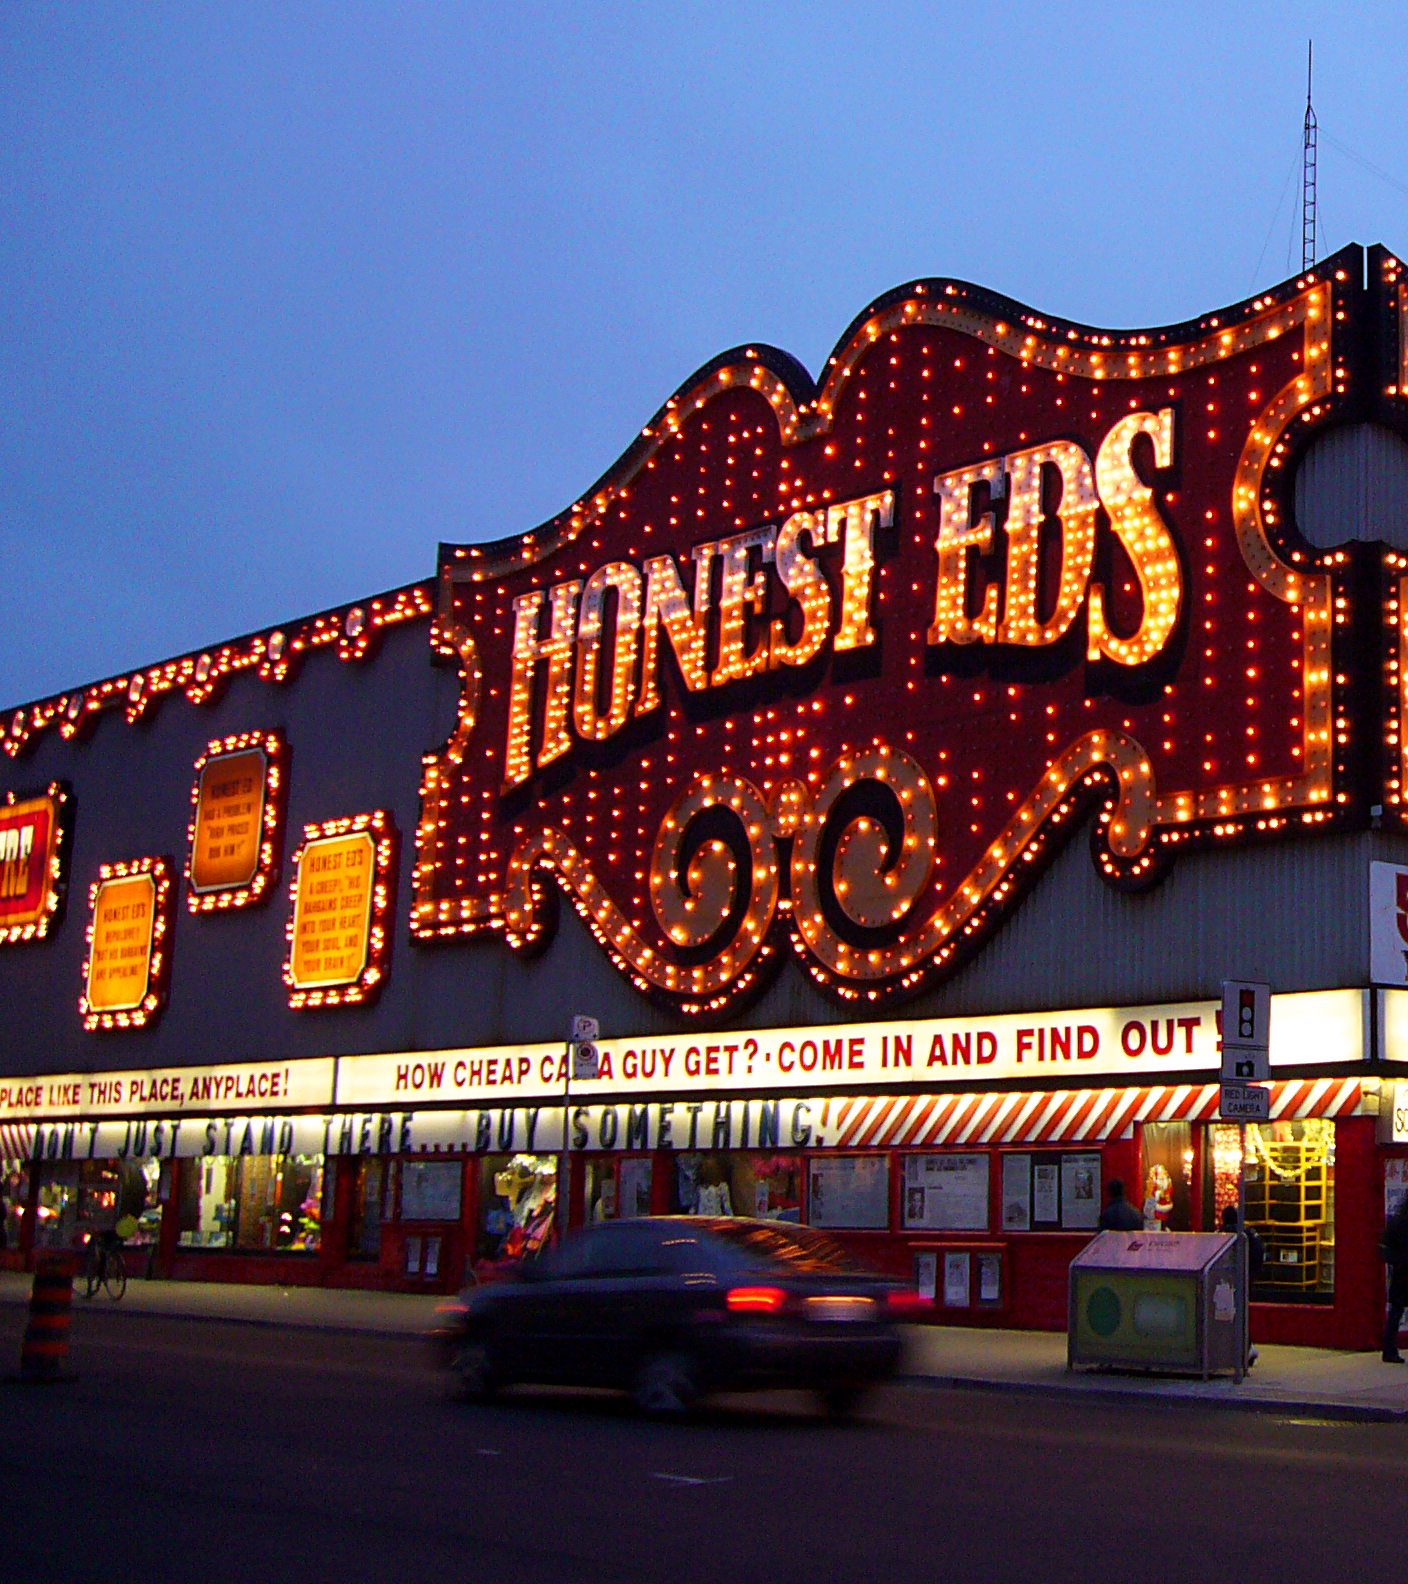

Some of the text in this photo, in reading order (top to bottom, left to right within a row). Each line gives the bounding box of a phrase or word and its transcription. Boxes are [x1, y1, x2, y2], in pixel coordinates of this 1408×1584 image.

[504, 408, 1183, 785] HONEST EDS
[396, 1062, 445, 1090] HOW
[454, 1057, 531, 1087] CHEAP
[599, 1051, 614, 1080] A
[622, 1047, 676, 1079] GUY
[684, 1038, 758, 1077] GET?
[779, 1037, 865, 1073] COME
[881, 1034, 913, 1068] IN
[927, 1031, 998, 1067] AND
[1016, 1024, 1100, 1063] FIND
[0, 1068, 290, 1108] PLACE LIKE THIS PLACE, ANYPLACE!
[1225, 1089, 1264, 1101] RED LIGHT
[1227, 1102, 1261, 1113] CAMERA
[118, 1120, 181, 1158] JUST
[204, 1117, 293, 1156] STAND
[475, 1108, 538, 1151] BUY
[572, 1100, 830, 1150] SOMETHING!
